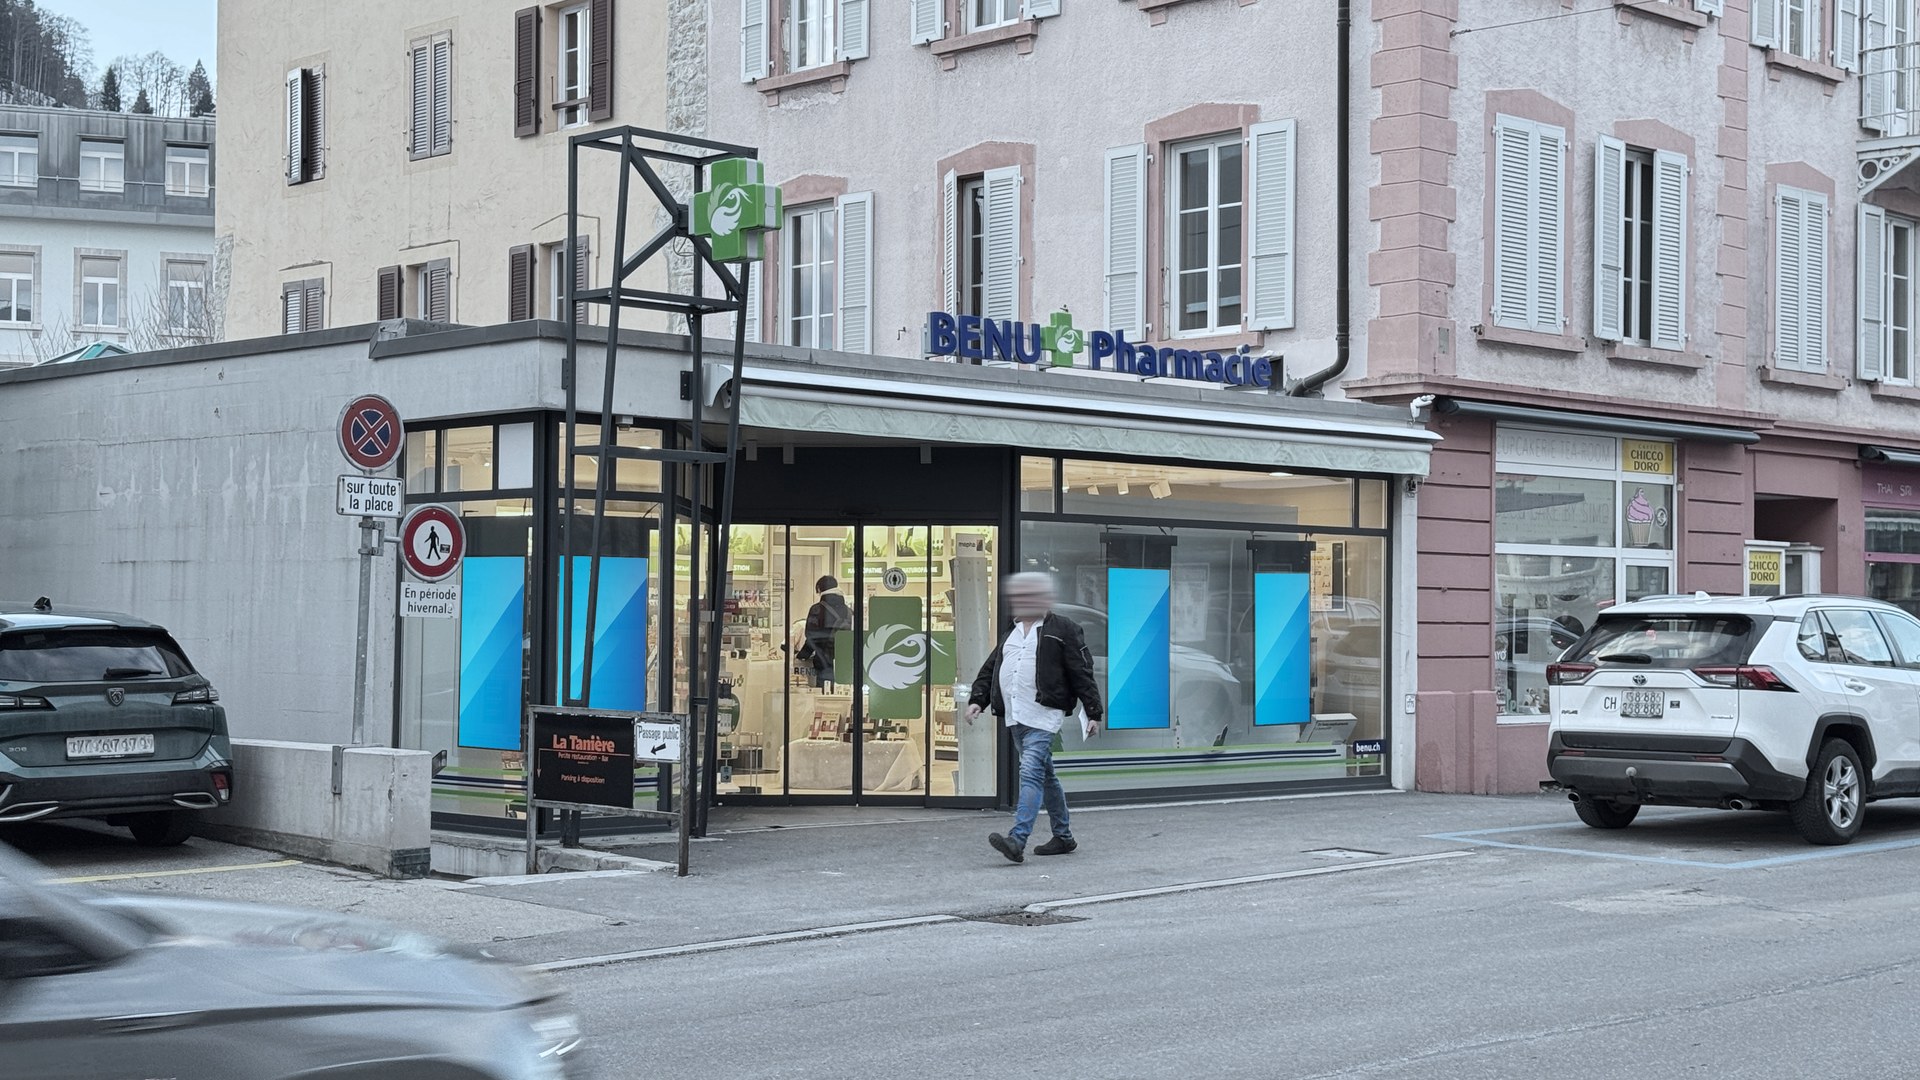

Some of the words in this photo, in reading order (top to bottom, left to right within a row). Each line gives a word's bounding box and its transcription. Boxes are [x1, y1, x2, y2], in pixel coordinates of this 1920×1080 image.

[927, 311, 1041, 364] BENU
[1090, 329, 1273, 388] Pharmacie
[1631, 449, 1664, 461] CHICCO
[346, 483, 366, 495] sur
[368, 481, 397, 496] toute
[349, 495, 360, 509] la
[364, 496, 394, 512] place
[1749, 560, 1779, 571] CHICCO
[405, 588, 417, 599] En
[419, 588, 457, 605] période
[1603, 696, 1617, 710] CH
[638, 725, 662, 741] Passage
[662, 726, 679, 743] public
[553, 734, 567, 749] La
[569, 735, 615, 753] Tanière
[1355, 742, 1381, 753] benu.ch
[561, 774, 577, 783] Parking
[581, 775, 606, 784] disposition
